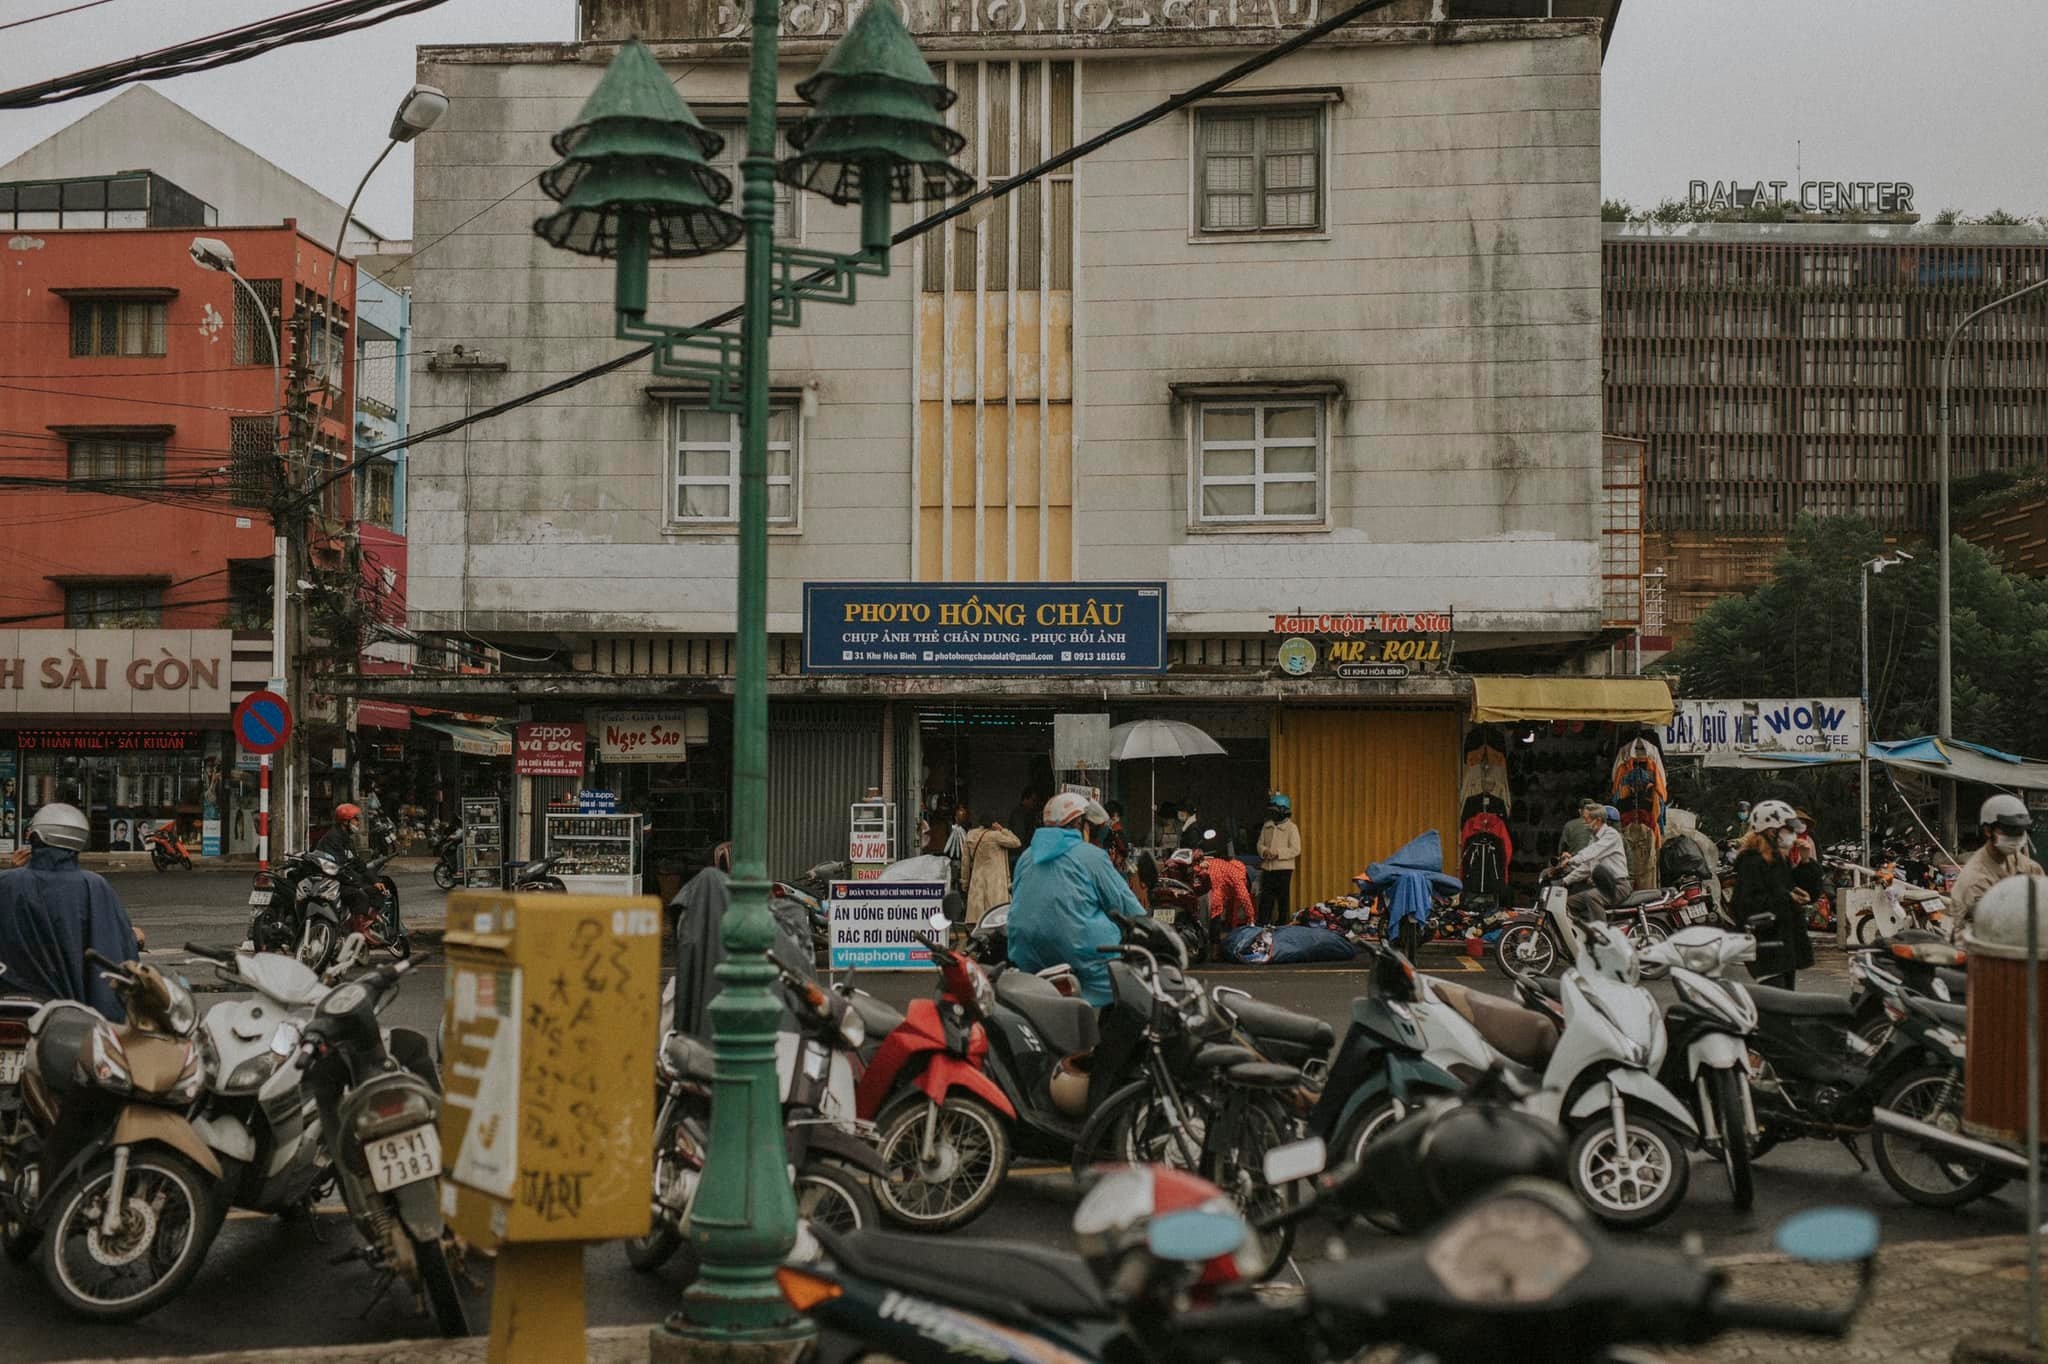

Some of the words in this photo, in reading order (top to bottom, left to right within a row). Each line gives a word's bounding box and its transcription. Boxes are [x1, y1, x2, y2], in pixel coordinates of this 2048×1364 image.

[1800, 181, 1914, 211] CENTER
[844, 603, 931, 623] PHOTO
[938, 595, 1027, 626] HỒNG
[1036, 598, 1124, 626] CHÂU
[1274, 614, 1315, 633] Kem
[1318, 613, 1365, 637] Cuộn
[1378, 613, 1408, 633] Trà
[1414, 612, 1451, 633] Sữa
[842, 632, 878, 645] CHỤP
[882, 629, 910, 643] ẢNH
[913, 629, 940, 643] THẺ
[943, 630, 980, 643] CHÂN
[983, 633, 1020, 643] DUNG
[1031, 633, 1066, 645] PHỤC
[1070, 629, 1094, 643] HỒI
[1098, 630, 1126, 643] ẢNH
[854, 652, 864, 660] 31
[866, 652, 882, 660] Khu
[934, 652, 1053, 662] photohongchaudalat@gmail.com
[1074, 652, 1094, 661] 0913
[1097, 652, 1126, 661] 181616
[1328, 640, 1367, 661] MR
[1382, 640, 1442, 661] ROLL
[40, 648, 109, 690] SÀI
[126, 647, 220, 690] GÒN
[1764, 705, 1846, 734] WOW
[529, 726, 572, 740] zippo
[606, 725, 647, 753] Ngọc
[650, 724, 681, 746] Sao
[1796, 734, 1849, 746] COFEE
[865, 843, 886, 858] KHO
[853, 902, 884, 921] UỐNG
[887, 904, 918, 921] ĐÚNG
[838, 928, 861, 943] RÁC
[864, 930, 882, 943] RƠI
[837, 950, 906, 963] vinaphone
